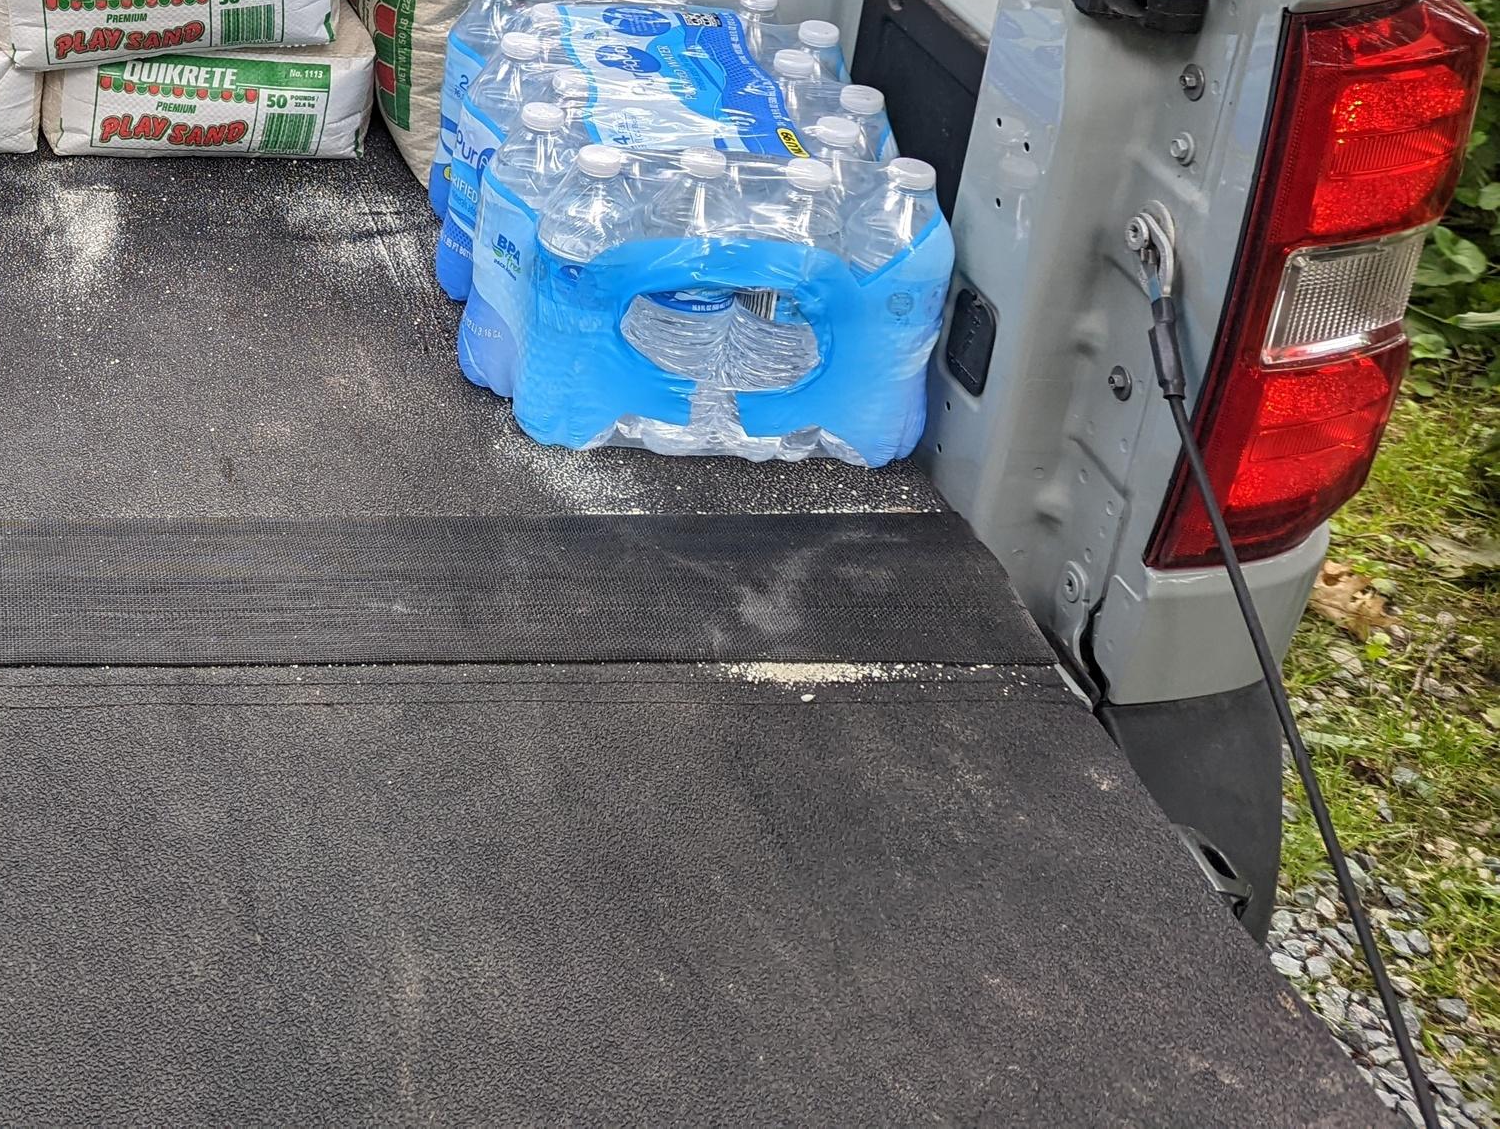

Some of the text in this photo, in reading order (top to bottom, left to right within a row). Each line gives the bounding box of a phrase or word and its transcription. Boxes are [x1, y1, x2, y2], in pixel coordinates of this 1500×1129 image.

[106, 13, 147, 23] PREMIUM
[54, 20, 205, 60] PLAY SAND
[122, 60, 238, 89] QUIKRETE
[289, 69, 323, 79] No. 1113
[156, 101, 196, 114] PREMIUM
[267, 94, 288, 109] 50
[100, 114, 249, 147] PLAY SAND
[497, 233, 521, 265] BPA
